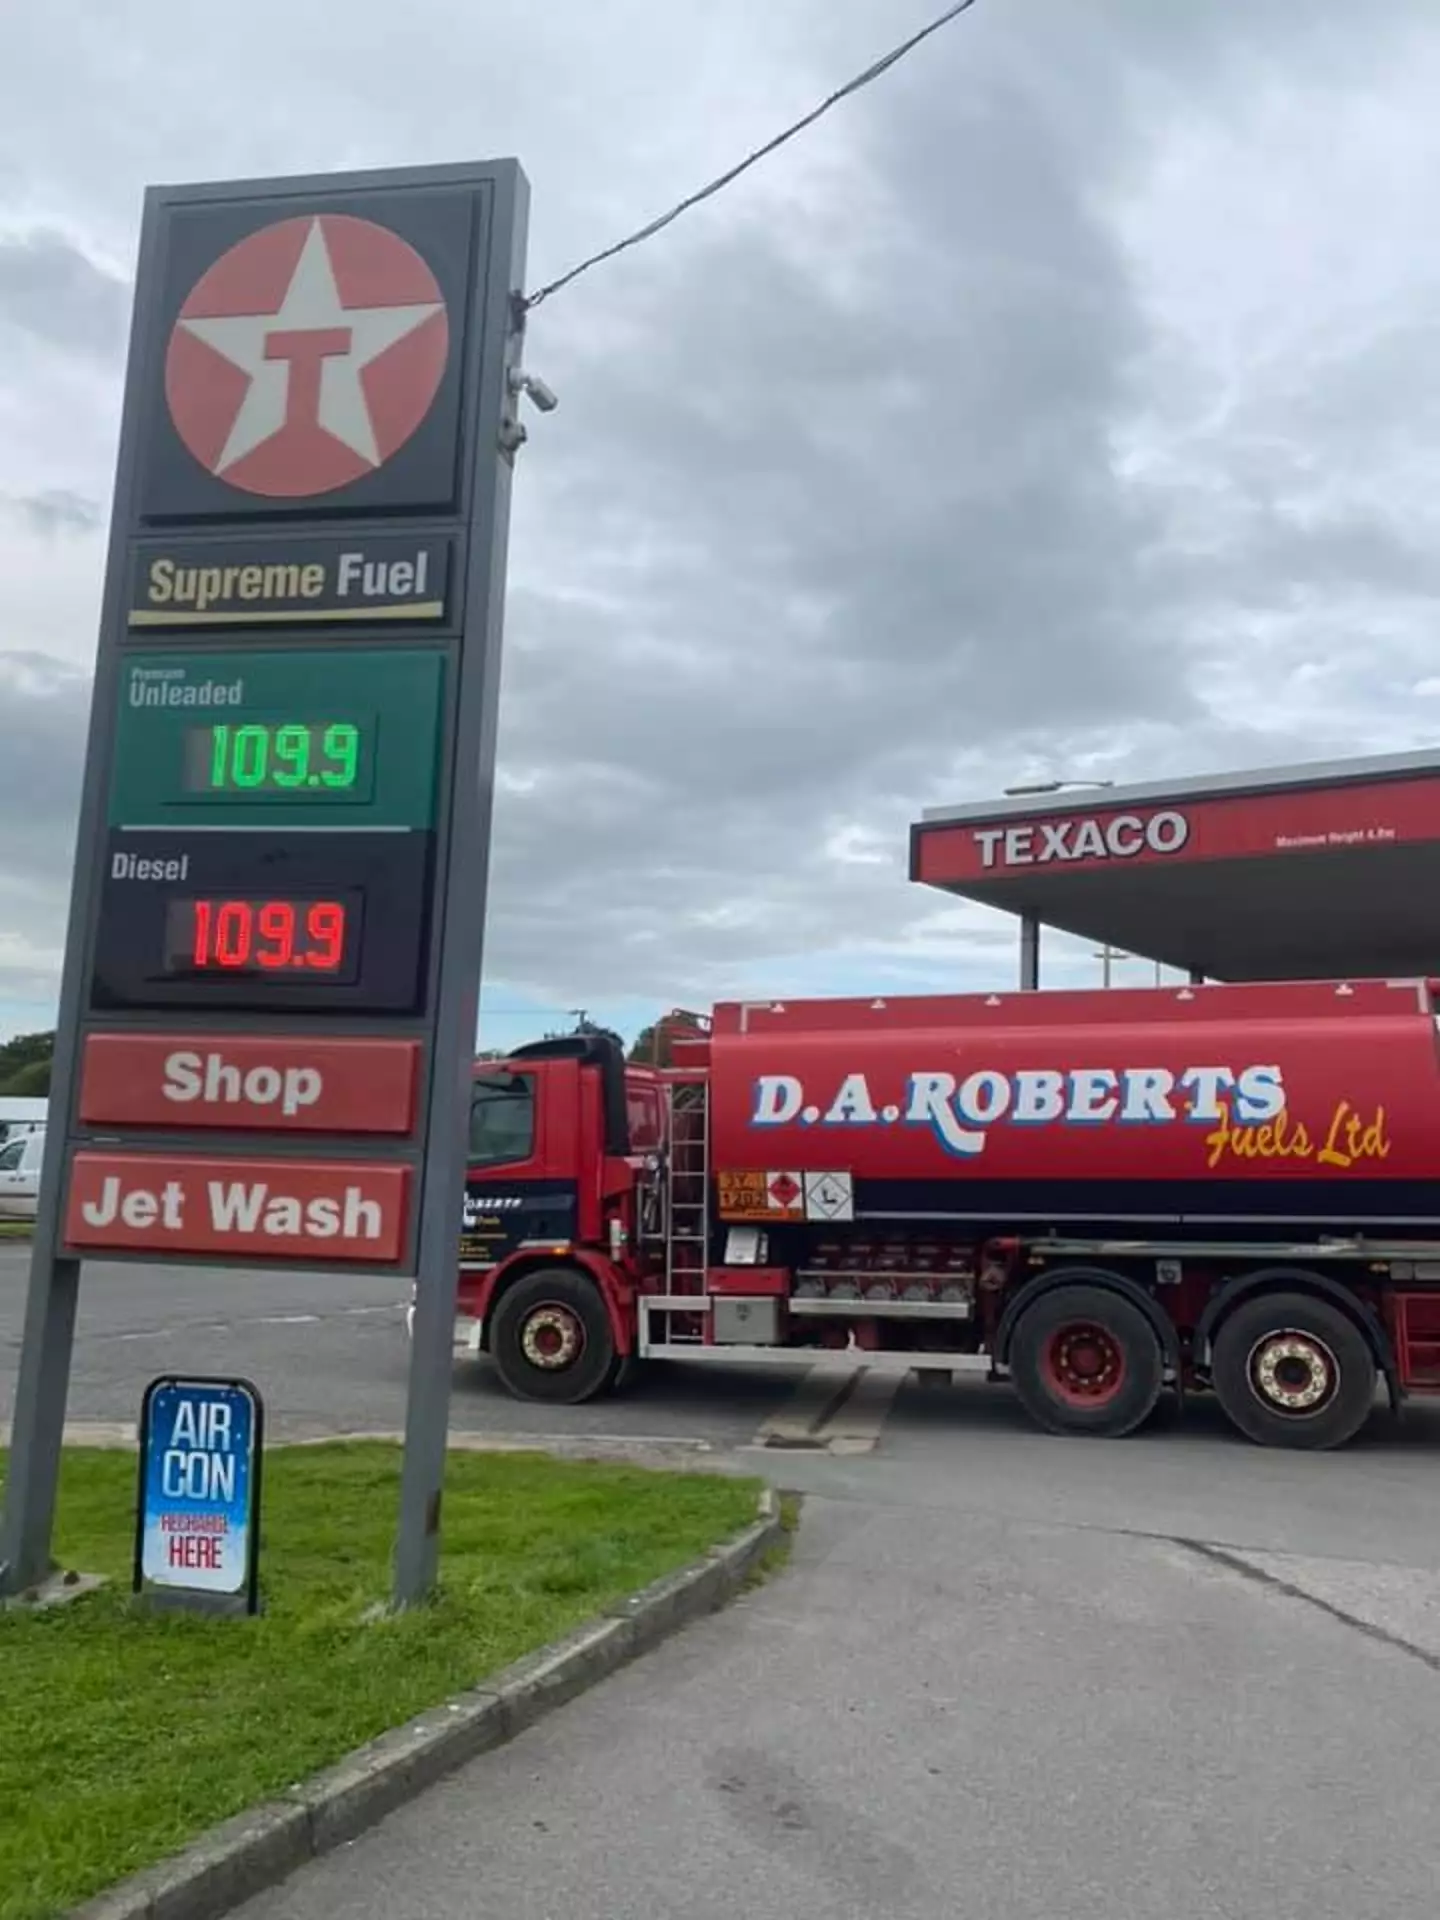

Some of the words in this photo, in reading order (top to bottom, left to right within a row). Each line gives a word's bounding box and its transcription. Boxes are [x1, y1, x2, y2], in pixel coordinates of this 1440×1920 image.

[148, 558, 325, 609] Supreme
[336, 551, 428, 597] Fuel
[129, 677, 243, 707] Unleaded
[211, 724, 359, 788] 109.9
[111, 853, 189, 881] Diesel
[974, 811, 1190, 868] TEXACO
[194, 901, 345, 968] 109.9
[162, 1051, 323, 1116] Shop
[1206, 1101, 1314, 1169] Fuels
[1317, 1101, 1391, 1168] Ltd
[82, 1177, 186, 1230] Jet
[208, 1181, 382, 1239] Wash
[170, 1401, 232, 1452] AIR
[162, 1449, 235, 1502] CON
[169, 1535, 223, 1568] HERE
